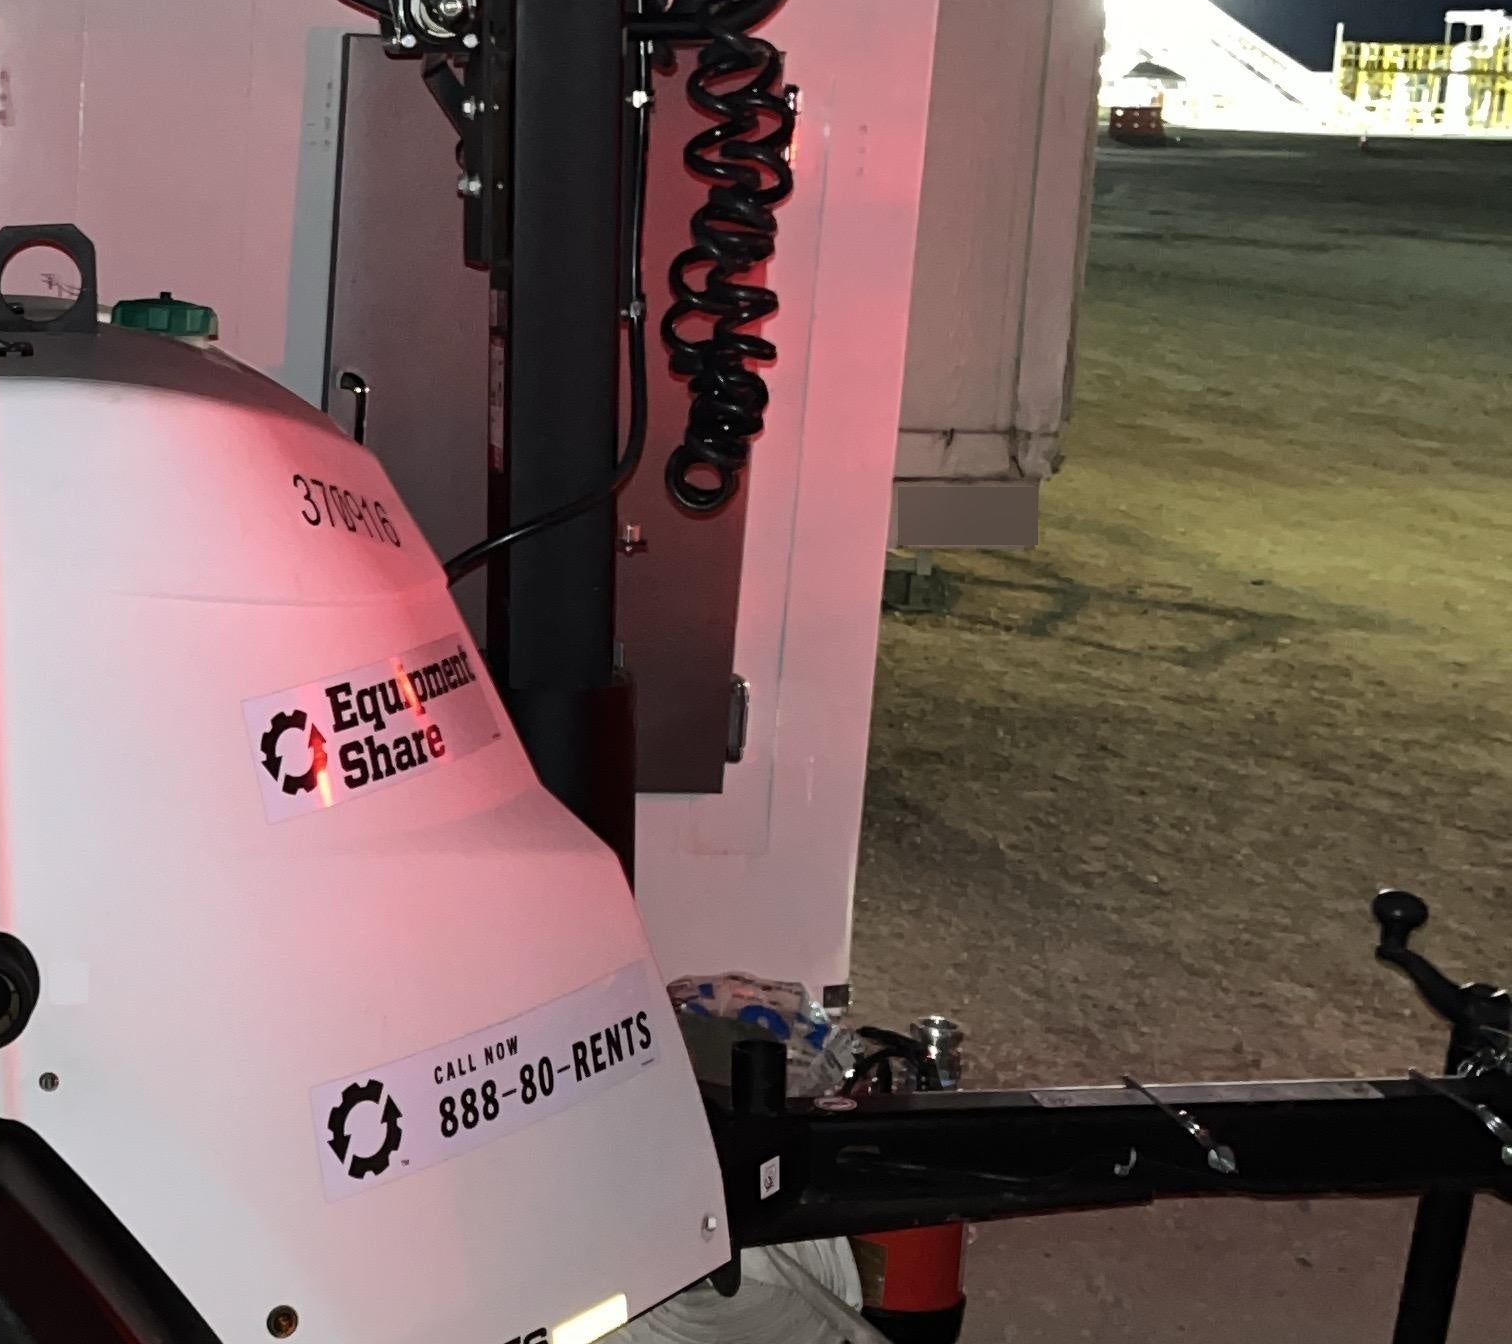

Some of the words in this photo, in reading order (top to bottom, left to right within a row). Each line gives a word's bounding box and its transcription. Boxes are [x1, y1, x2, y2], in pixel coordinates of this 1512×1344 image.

[292, 474, 401, 548] 370916
[338, 723, 446, 790] Share
[433, 1054, 477, 1085] CALL
[484, 1035, 518, 1066] NOW
[438, 1010, 652, 1138] 888-80-RENTS
